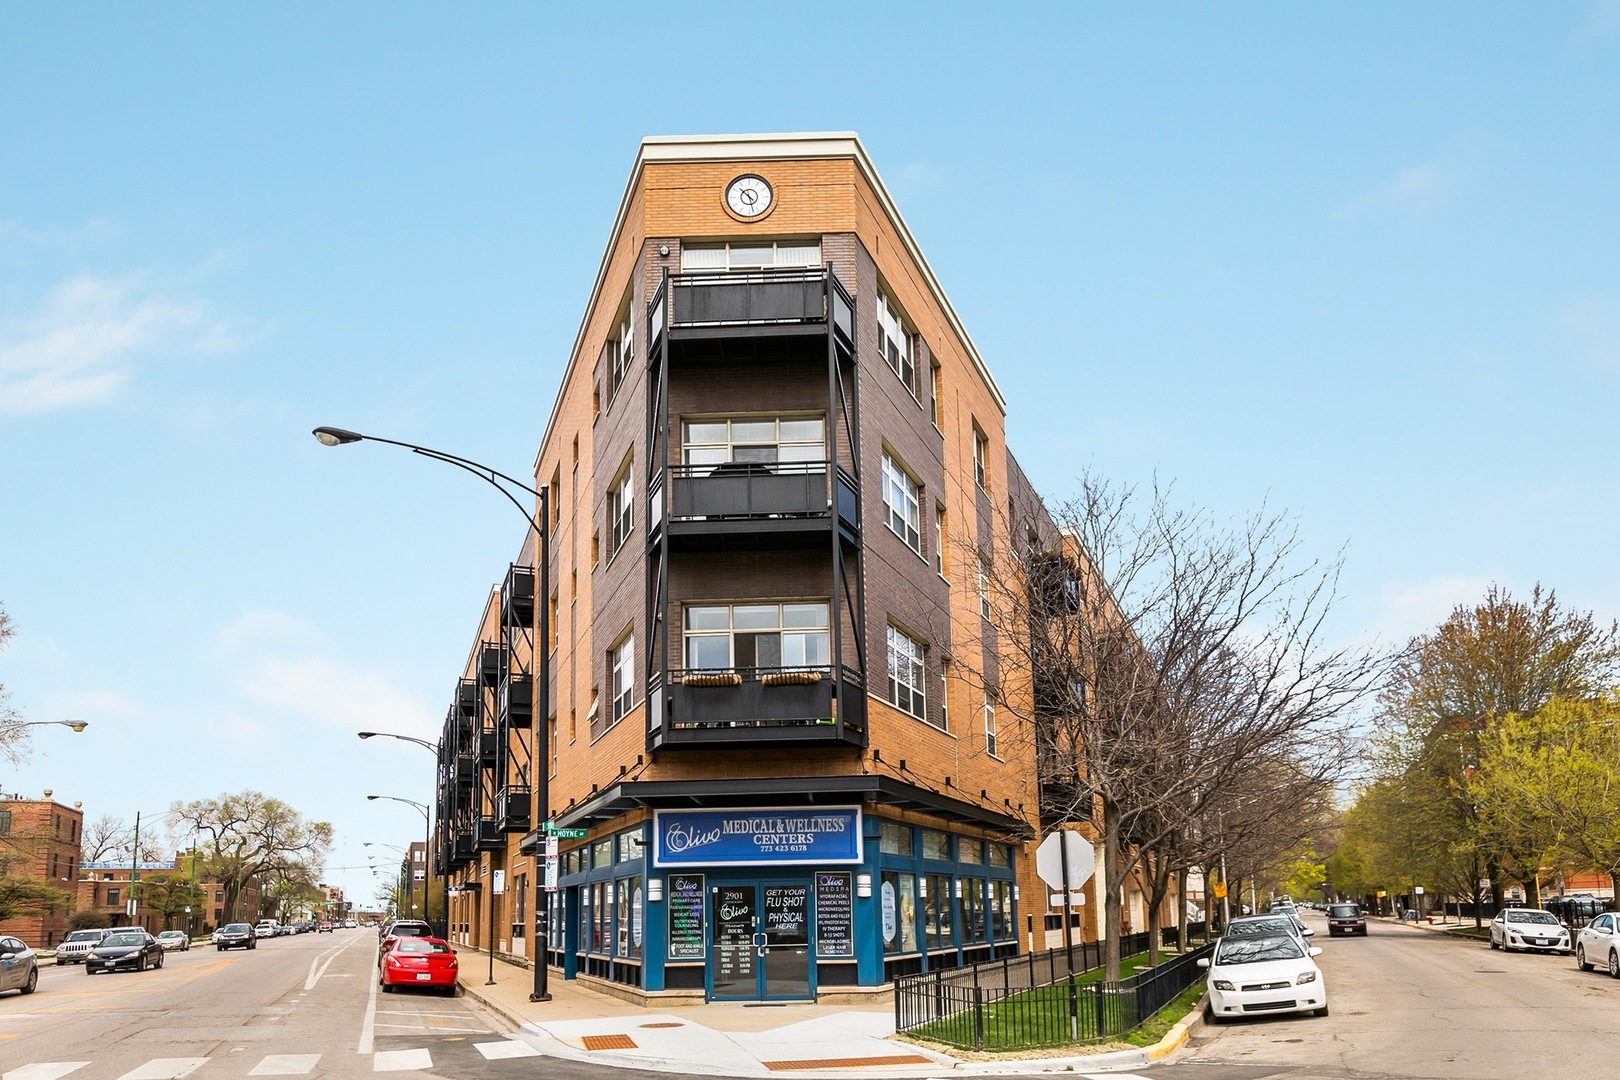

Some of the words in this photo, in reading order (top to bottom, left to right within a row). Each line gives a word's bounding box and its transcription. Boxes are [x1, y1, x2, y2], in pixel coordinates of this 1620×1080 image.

[666, 822, 722, 853] Olivo
[753, 833, 814, 844] CENTERS
[724, 892, 743, 900] 2901
[766, 897, 782, 907] FLU
[782, 896, 804, 906] SHOT
[720, 904, 748, 920] Olivo
[768, 912, 804, 922] PHYSICAL
